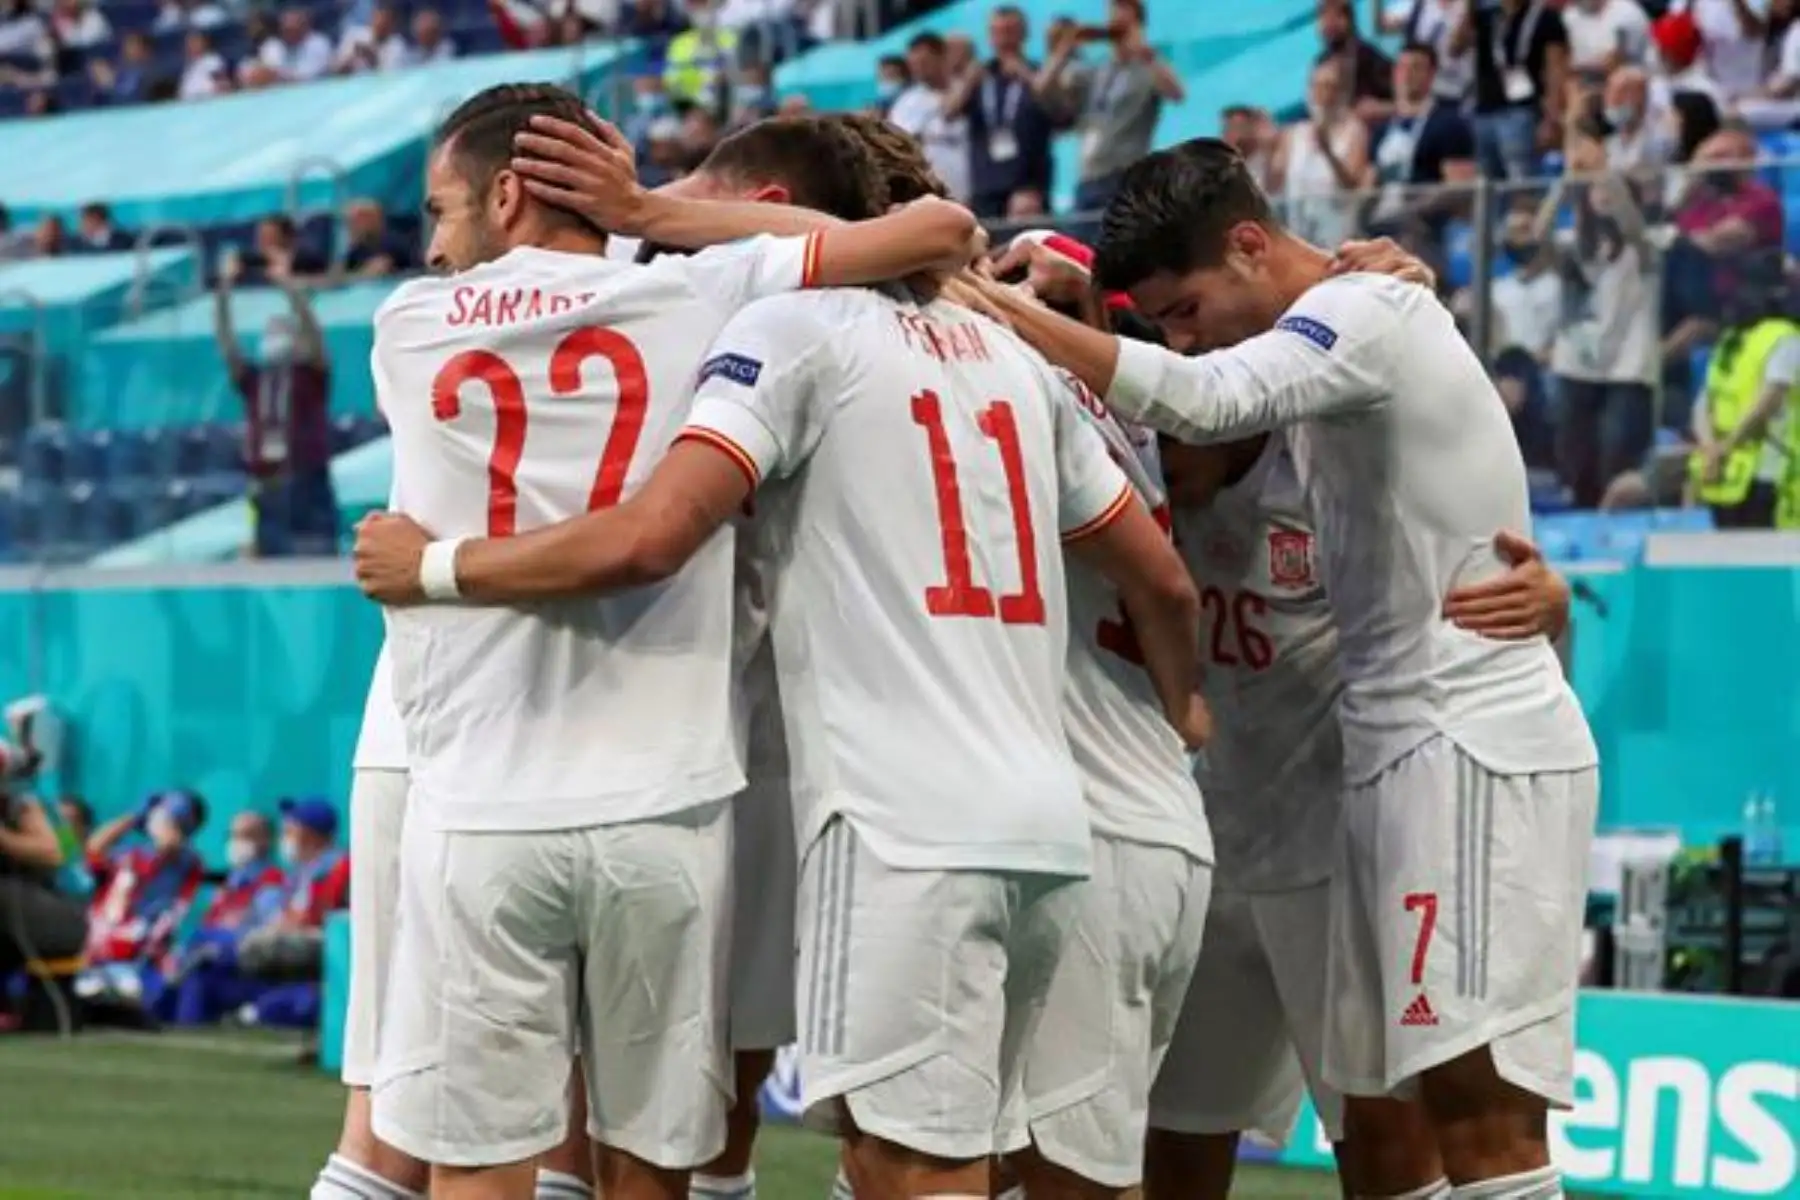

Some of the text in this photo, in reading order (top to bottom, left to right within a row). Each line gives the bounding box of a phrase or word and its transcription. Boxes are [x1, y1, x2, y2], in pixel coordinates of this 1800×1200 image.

[432, 325, 649, 538] 22
[910, 388, 1046, 625] 11
[1201, 586, 1273, 670] 26
[1404, 892, 1437, 984] 7
